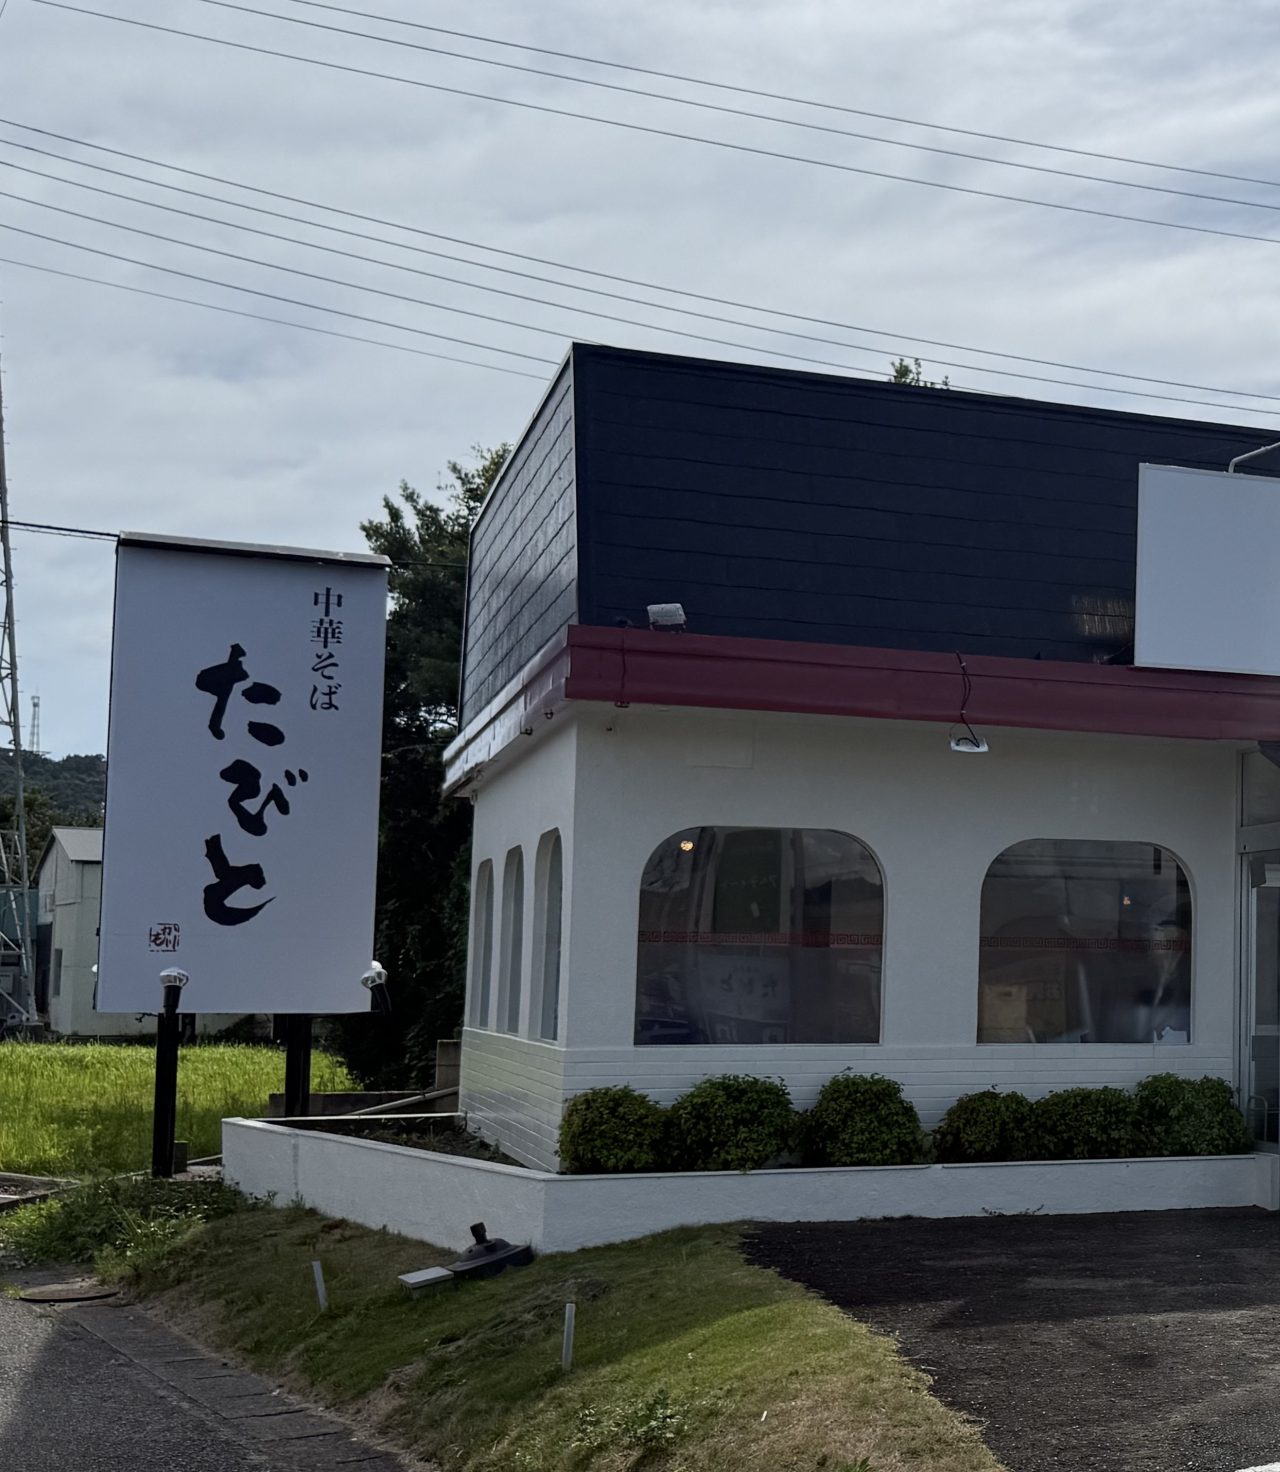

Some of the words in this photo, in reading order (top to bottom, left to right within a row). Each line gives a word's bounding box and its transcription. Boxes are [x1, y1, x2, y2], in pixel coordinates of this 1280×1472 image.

[309, 586, 344, 711] 中華そば
[195, 643, 308, 926] たびと
